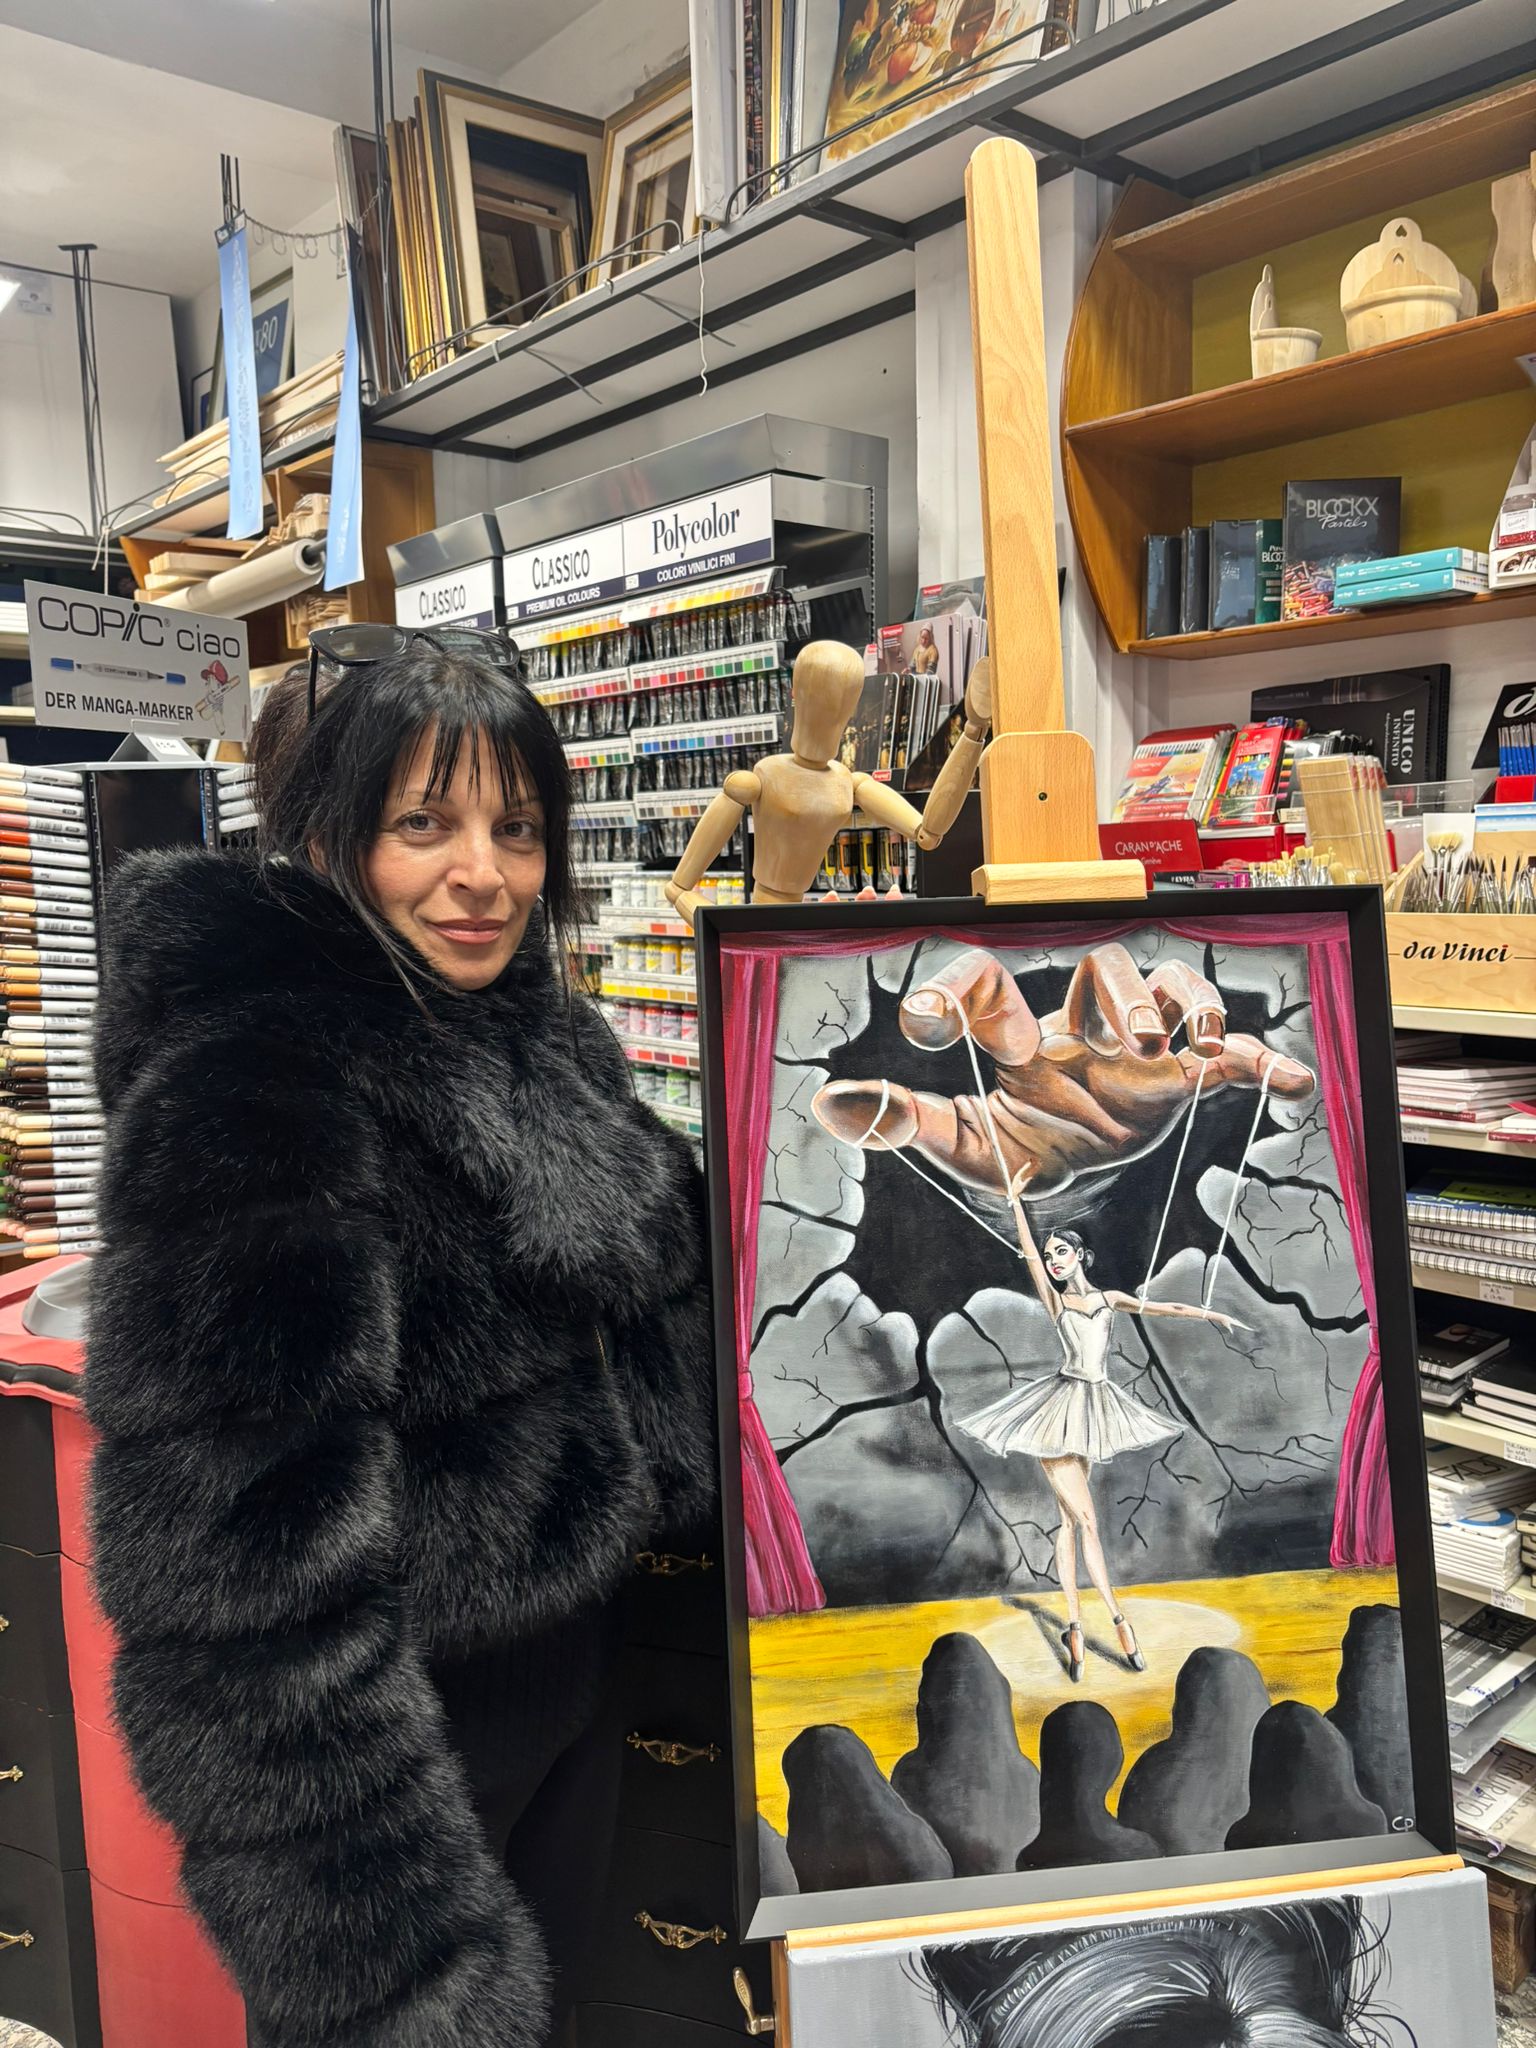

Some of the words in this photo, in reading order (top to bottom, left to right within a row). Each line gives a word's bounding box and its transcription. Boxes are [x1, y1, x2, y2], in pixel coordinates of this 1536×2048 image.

[1306, 497, 1380, 519] BLOCKX
[1319, 514, 1368, 530] Pastels
[651, 501, 740, 559] Polycolor
[532, 549, 590, 590] CLASSICO
[656, 565, 687, 583] COLORI
[689, 556, 718, 575] VINILICI
[719, 552, 736, 568] FINI
[419, 584, 467, 621] CLASSICO
[526, 597, 556, 615] PREMIUM
[556, 595, 568, 607] OIL
[568, 587, 601, 605] COLOURS
[176, 623, 241, 659] ciao
[45, 690, 77, 710] DER
[82, 694, 195, 722] MANGA-MARKER
[1391, 717, 1401, 767] INFINITO
[1401, 708, 1415, 774] UNICO
[1402, 941, 1440, 960] da
[1442, 943, 1513, 963] Vinci
